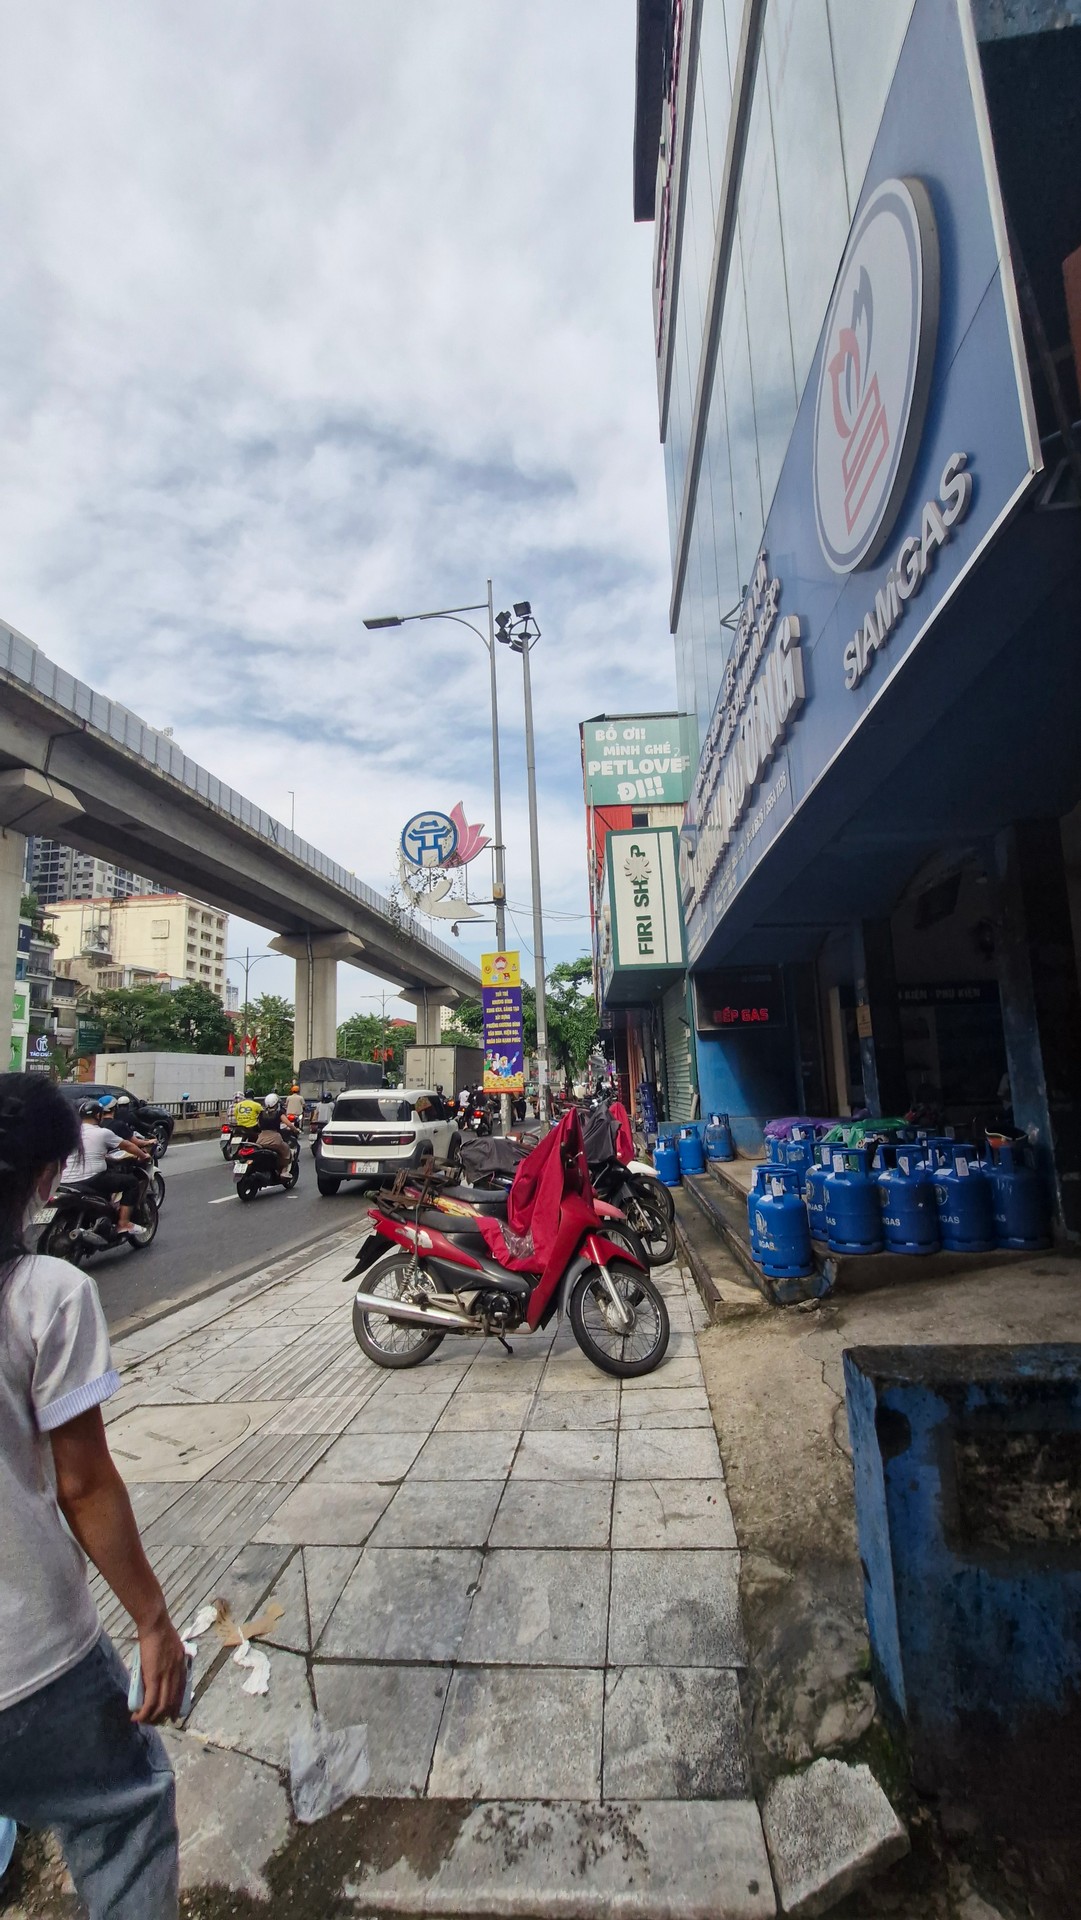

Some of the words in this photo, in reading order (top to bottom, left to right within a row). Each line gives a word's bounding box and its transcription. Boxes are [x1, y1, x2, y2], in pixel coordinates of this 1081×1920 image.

[843, 452, 972, 690] SIAMGAS
[595, 723, 617, 741] BỐ
[603, 743, 640, 756] MÌNH
[645, 741, 671, 755] GHÉ
[617, 776, 664, 801] ĐI!!
[636, 915, 654, 955] FIRI
[741, 1008, 769, 1021] GAS
[238, 1104, 253, 1114] be
